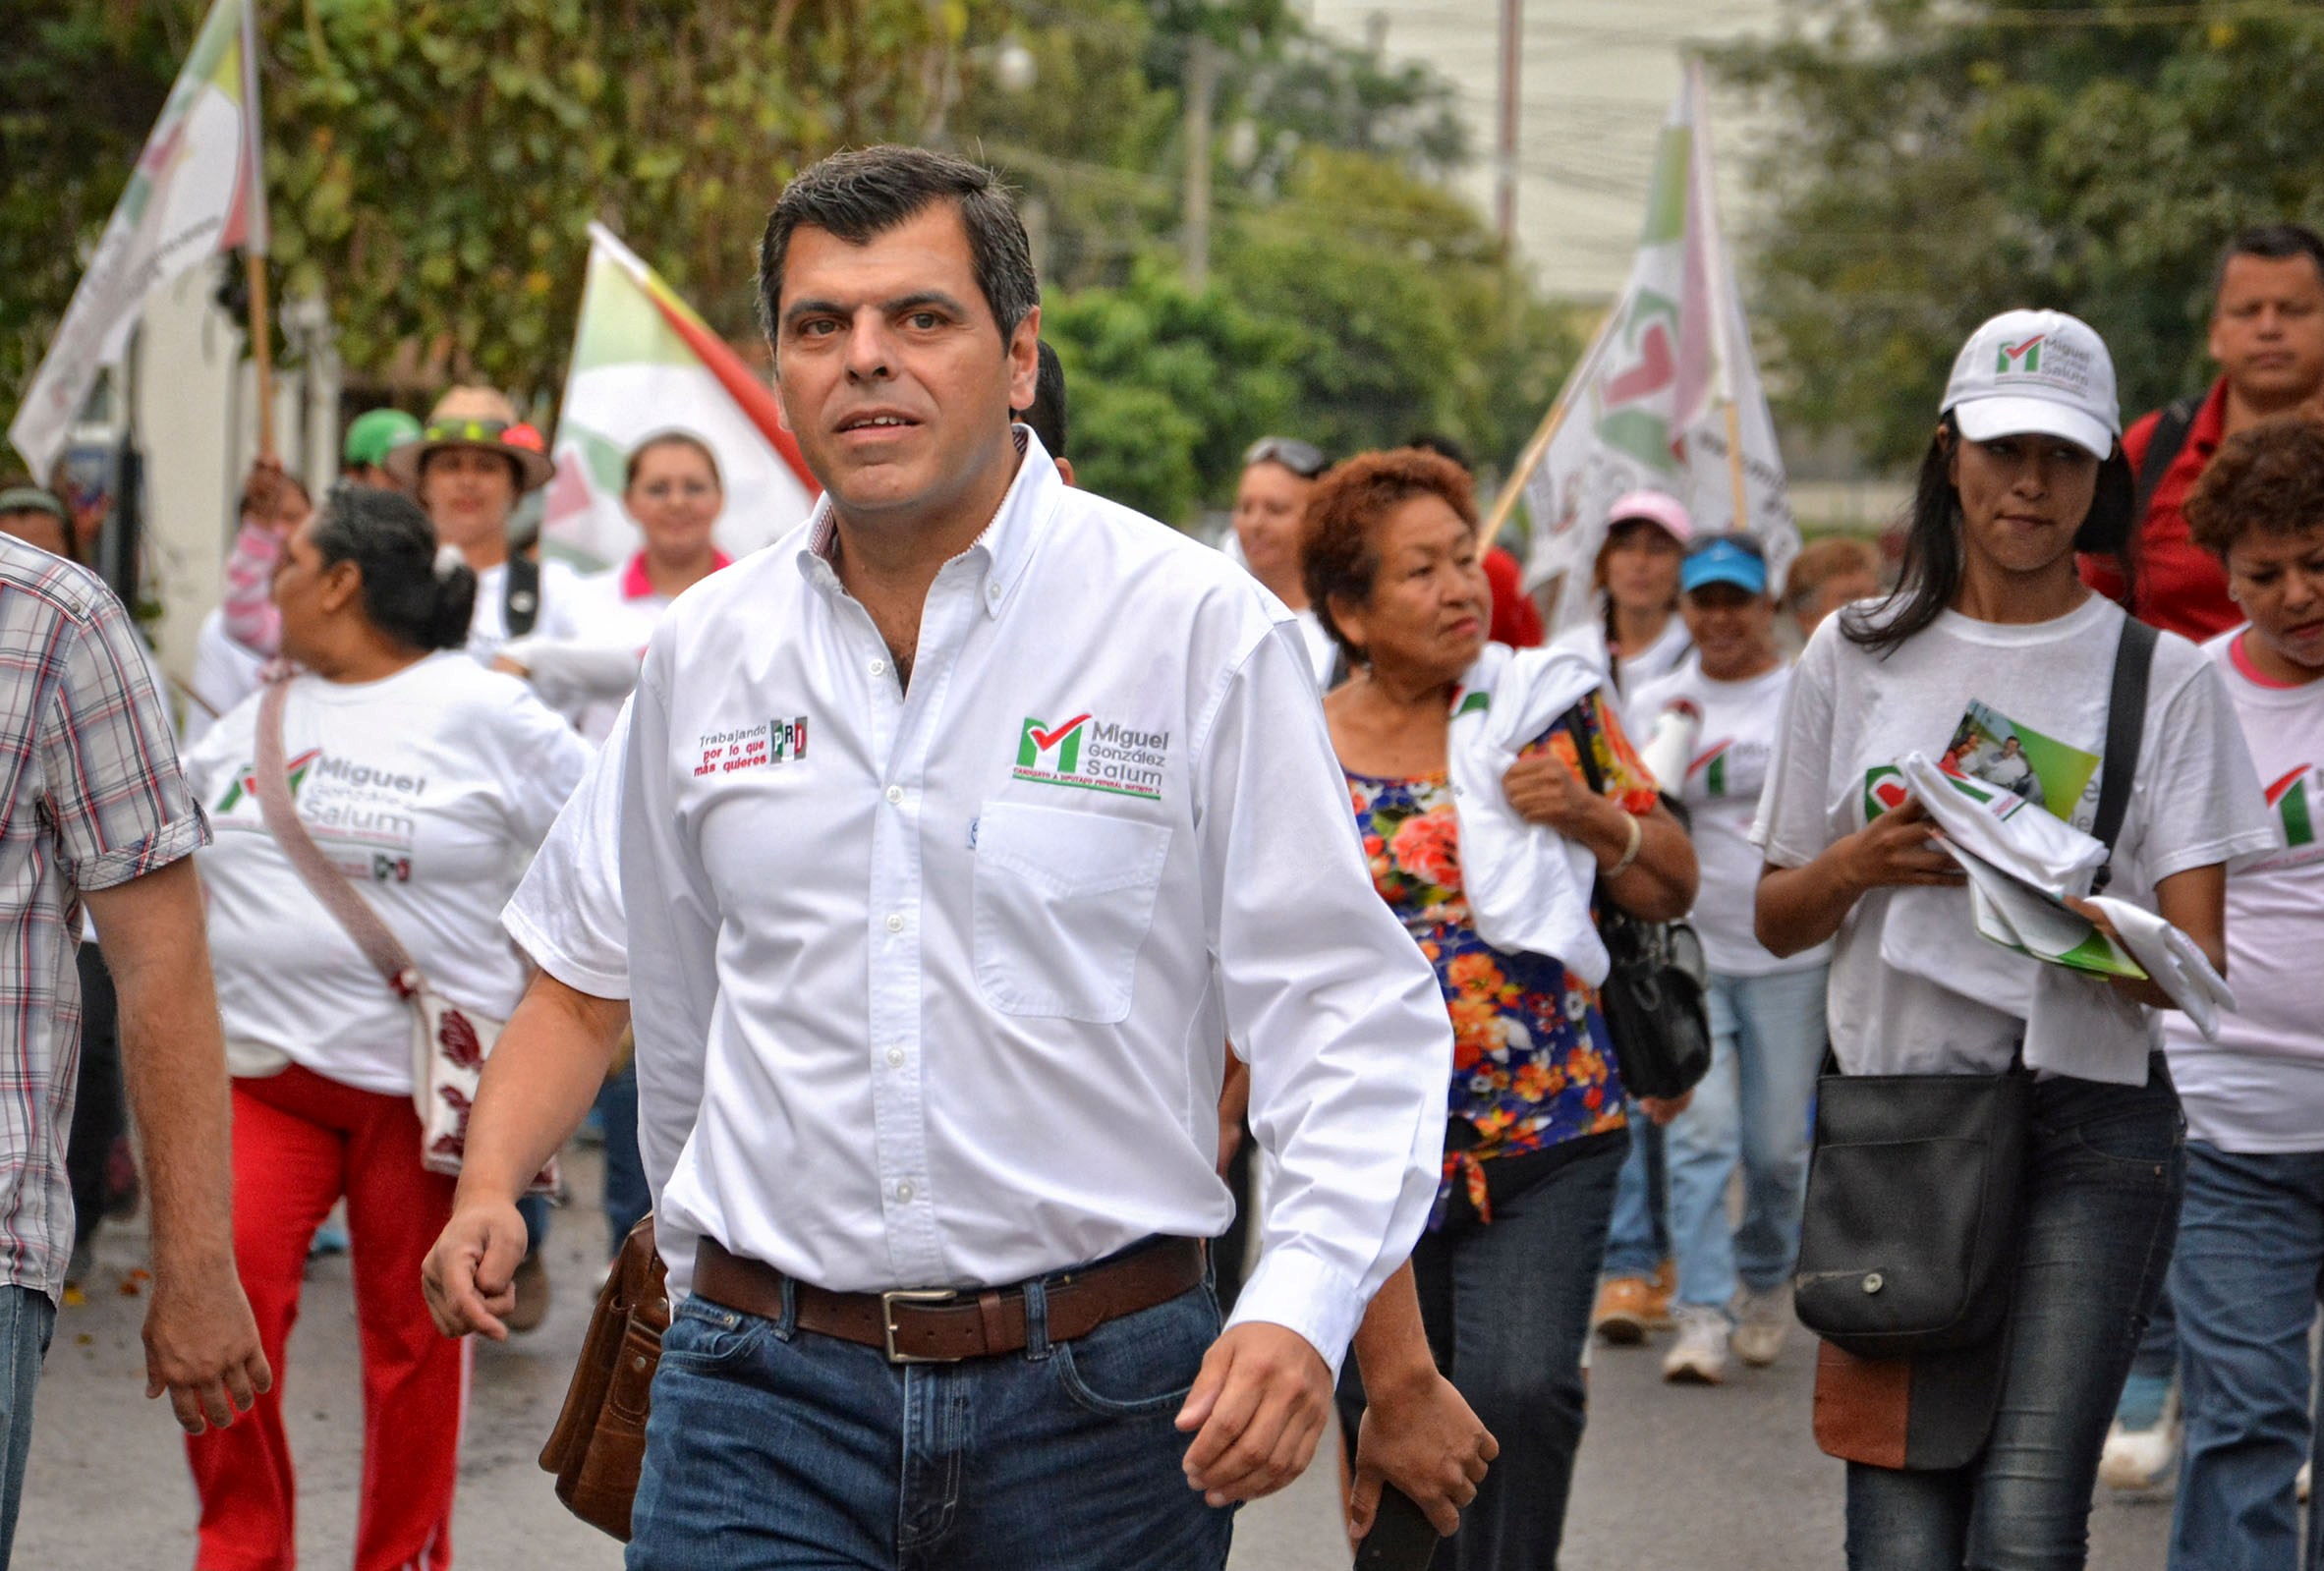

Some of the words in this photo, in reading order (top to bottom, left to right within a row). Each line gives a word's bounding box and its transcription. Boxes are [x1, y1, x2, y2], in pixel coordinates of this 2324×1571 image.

[699, 725, 766, 747] Trabajando
[1092, 721, 1169, 750] Miguel
[703, 748, 722, 763] por
[729, 744, 740, 757] lo
[746, 740, 765, 757] que
[1088, 743, 1166, 767] González
[314, 755, 427, 796] Miguel
[694, 760, 716, 777] más
[722, 754, 767, 773] quieres
[1086, 758, 1163, 787] Salum
[302, 798, 415, 835] Salum
